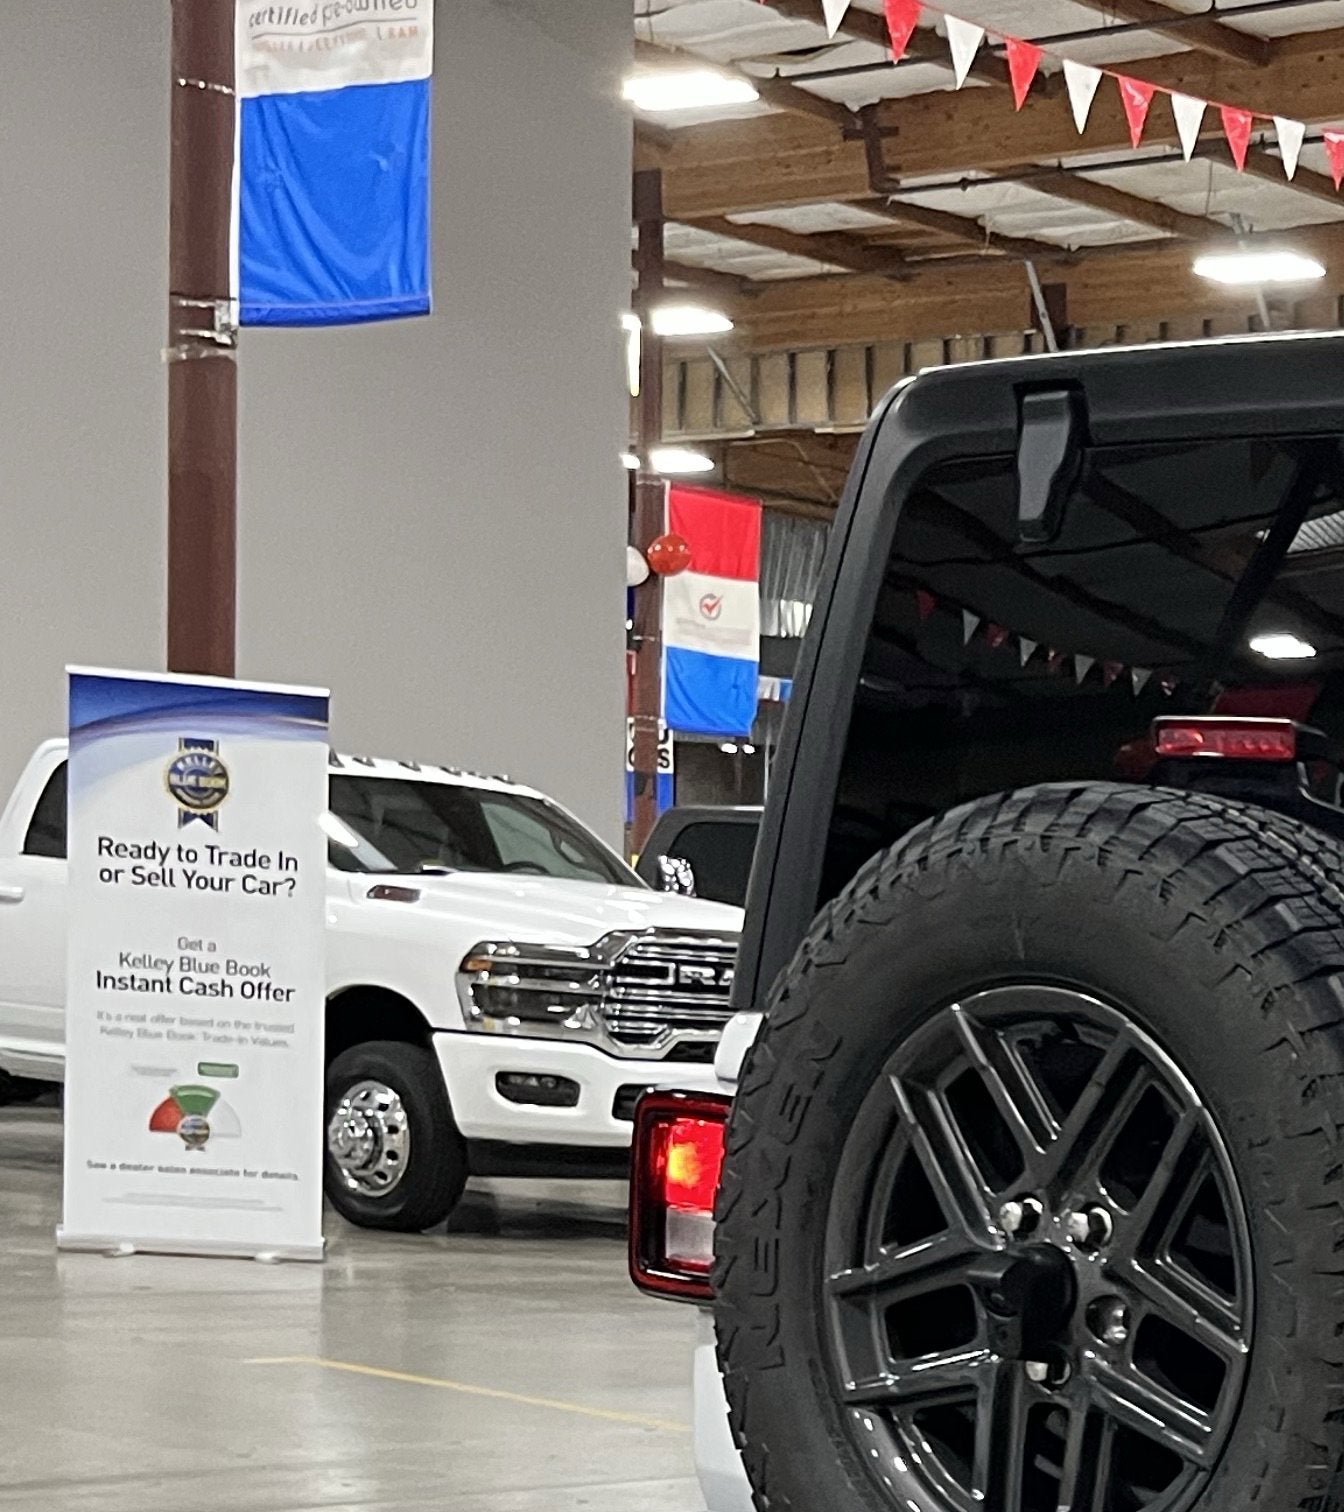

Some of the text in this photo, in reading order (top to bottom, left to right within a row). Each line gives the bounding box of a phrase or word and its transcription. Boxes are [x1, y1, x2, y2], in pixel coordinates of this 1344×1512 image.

[98, 836, 298, 872] Ready to Trade In
[100, 865, 296, 897] or Sell Your Car?
[177, 936, 217, 952] Get a
[119, 952, 271, 978] Kelley Blue Book
[96, 970, 296, 1002] Instant Cash Offer
